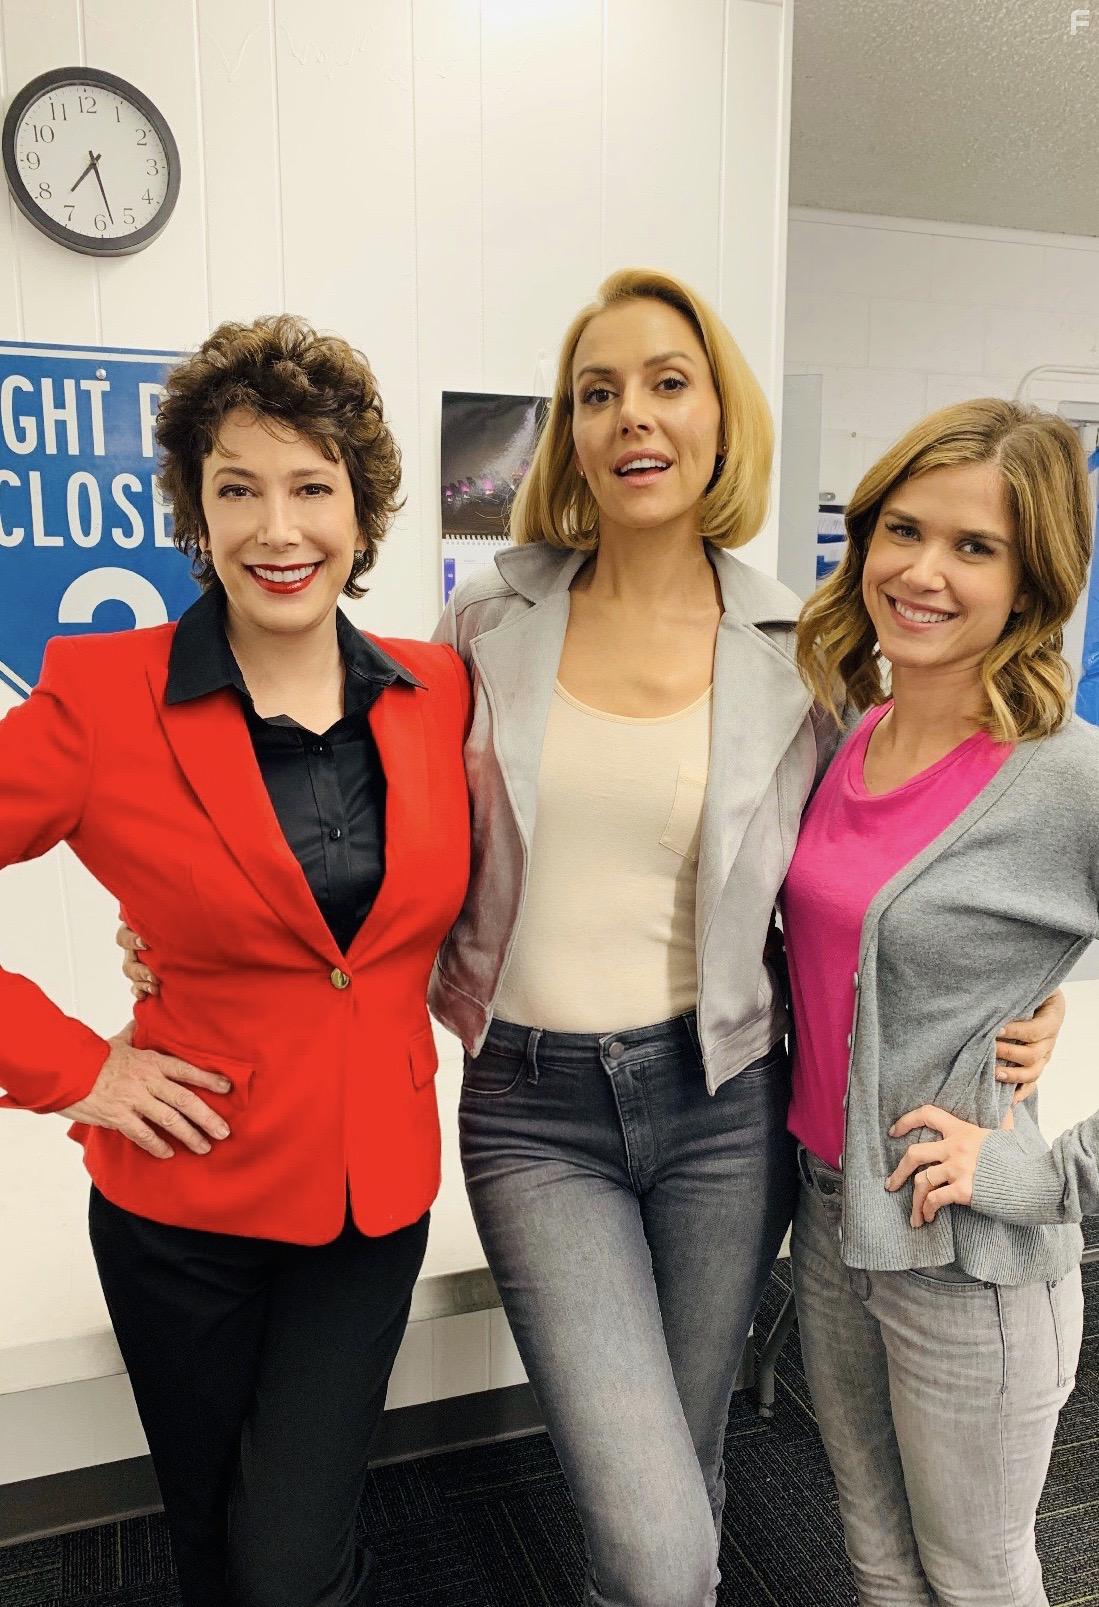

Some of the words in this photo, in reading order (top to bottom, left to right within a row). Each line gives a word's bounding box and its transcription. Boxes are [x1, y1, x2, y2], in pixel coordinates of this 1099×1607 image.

[50, 102, 67, 120] 11
[78, 96, 97, 114] 12
[33, 125, 55, 143] 10
[135, 128, 147, 145] 2
[26, 151, 40, 169] 9
[146, 158, 158, 175] 3
[39, 182, 52, 199] 8
[141, 189, 154, 205] 4
[63, 205, 76, 221] 7
[123, 208, 135, 225] 5
[94, 214, 106, 231] 6
[1, 375, 110, 455] GHT
